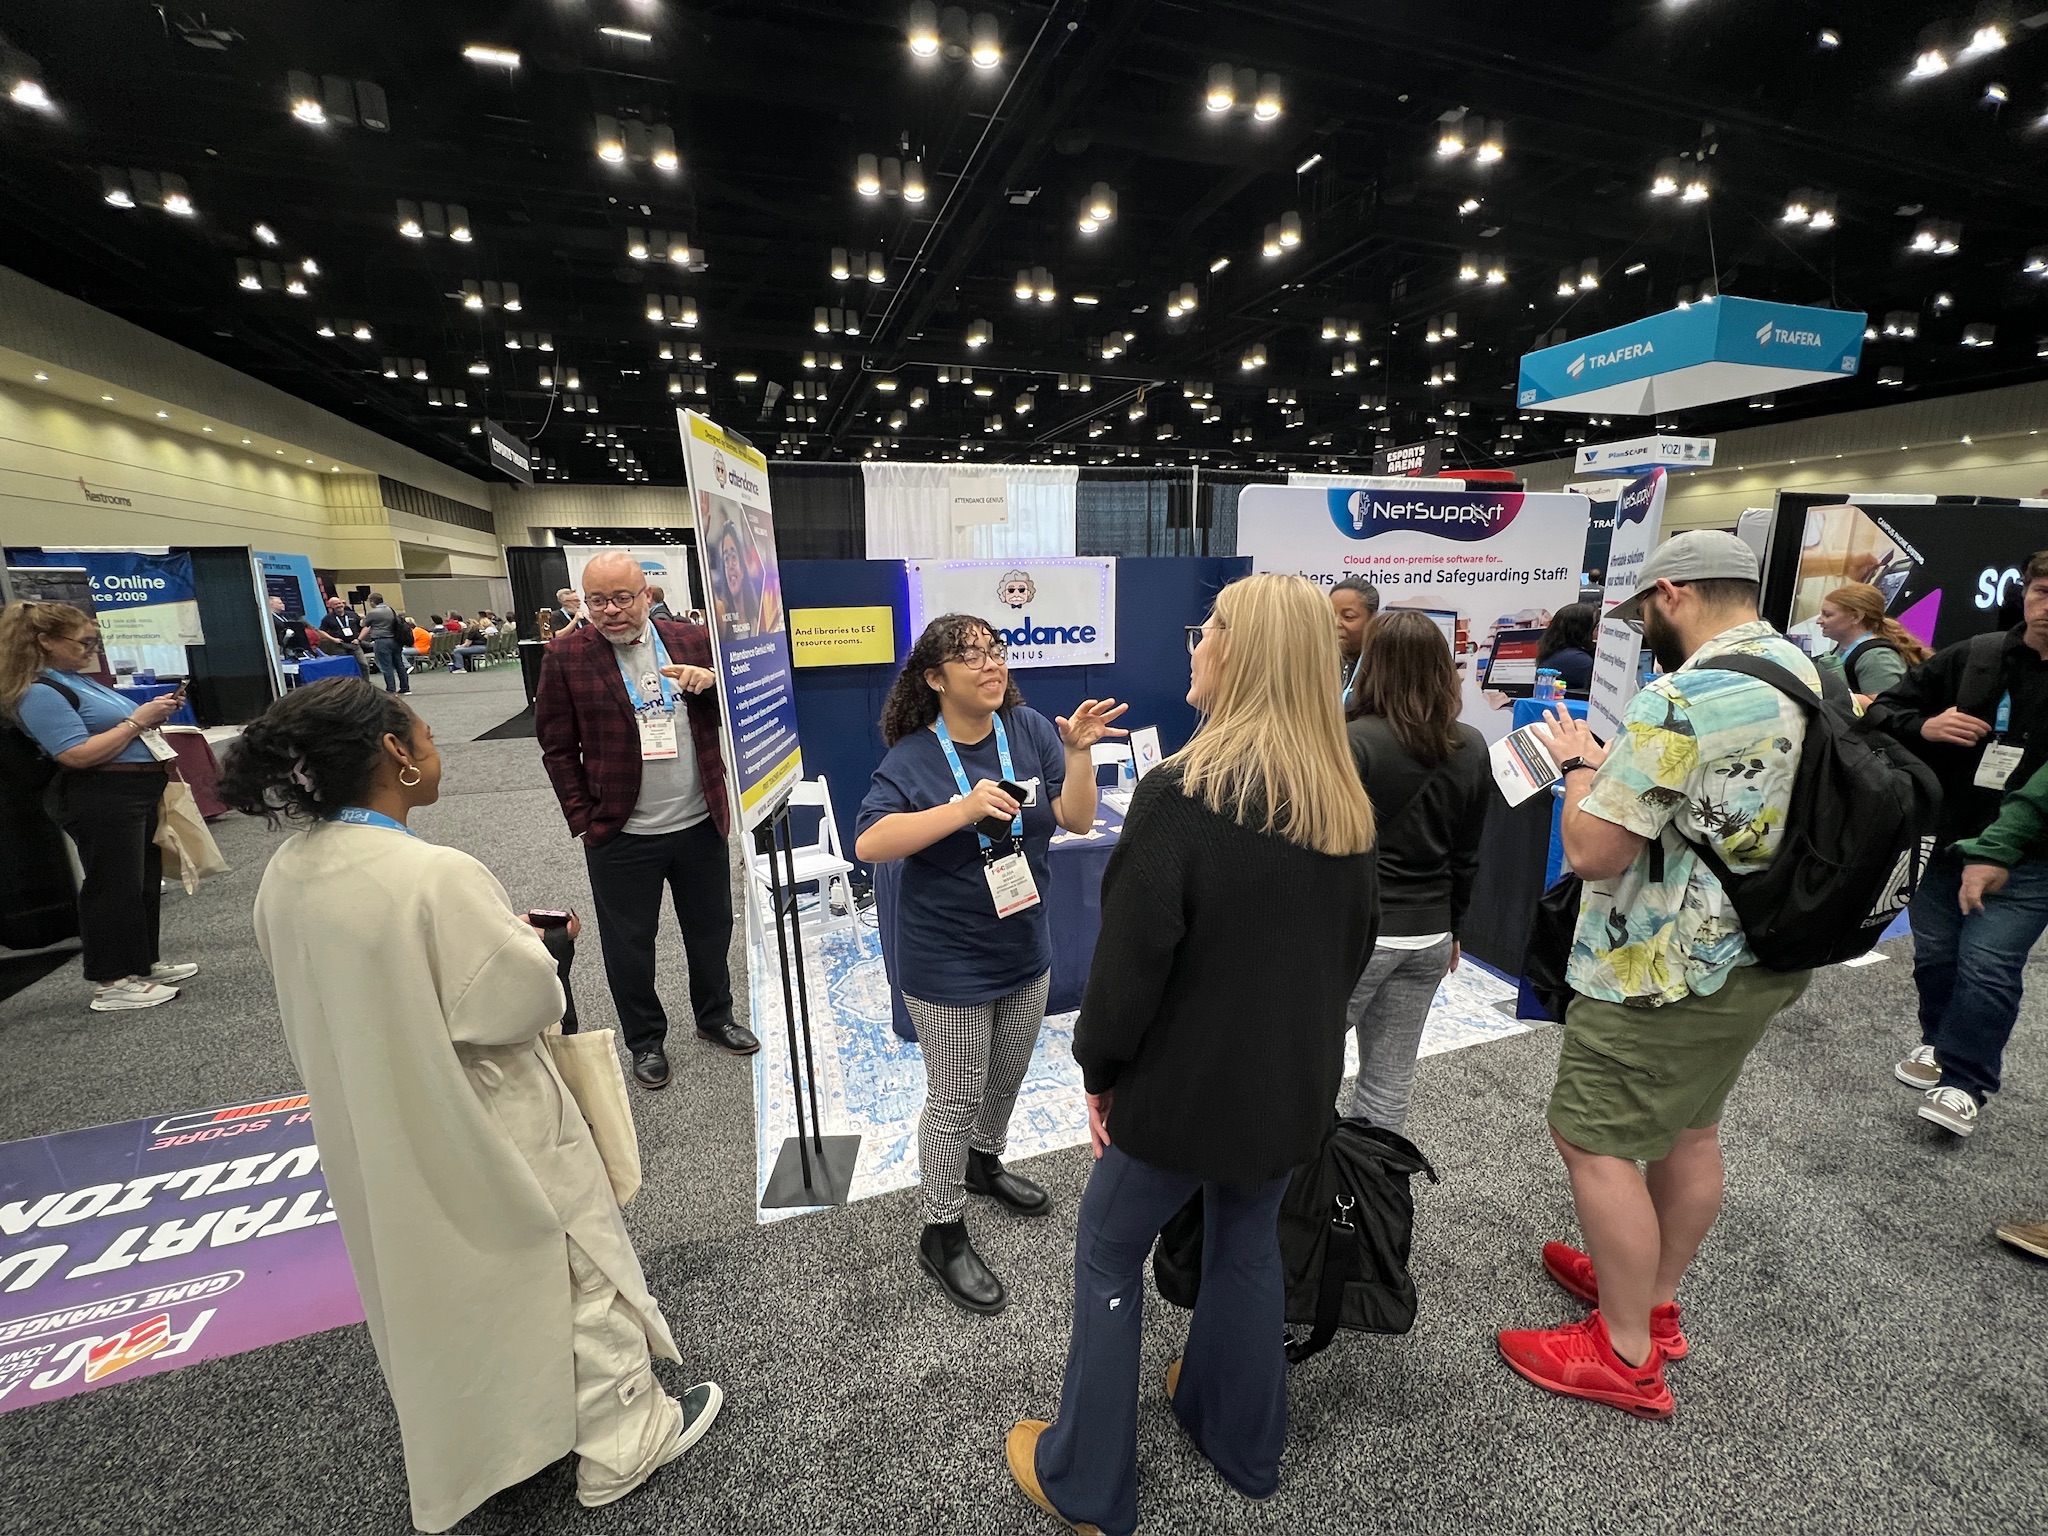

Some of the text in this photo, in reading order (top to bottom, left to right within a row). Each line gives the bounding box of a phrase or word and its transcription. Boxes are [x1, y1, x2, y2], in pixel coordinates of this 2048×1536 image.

[1775, 329, 1821, 347] TRAFERA
[1589, 341, 1654, 369] TRAFERA
[1387, 445, 1425, 462] ESPORTS
[1608, 447, 1648, 459] PlanSCAPE
[1661, 444, 1681, 455] YOZI
[1388, 457, 1423, 473] ARENA
[84, 489, 132, 507] Restrooms
[1372, 501, 1504, 524] NetSupport
[1593, 519, 1615, 528] TRAF
[1878, 516, 1895, 536] CAMPUS
[1906, 545, 1925, 565] SYSTEMS
[1343, 556, 1371, 564] Cloud
[1374, 555, 1391, 564] and
[1394, 555, 1444, 566] on-premise
[1446, 554, 1484, 563] software
[104, 575, 166, 590] Online
[1404, 569, 1432, 584] and
[1436, 568, 1529, 586] Safeguarding
[1533, 567, 1568, 581] Staff!
[115, 592, 148, 601] 2009
[795, 628, 812, 636] And
[814, 627, 849, 635] libraries
[999, 616, 1097, 647] ndance
[796, 639, 832, 647] resource
[1006, 651, 1043, 660] NIUS
[147, 1118, 271, 1151] SCORE
[0, 1144, 322, 1235] VILION
[0, 1244, 69, 1293] U
[138, 1275, 231, 1309] GAME
